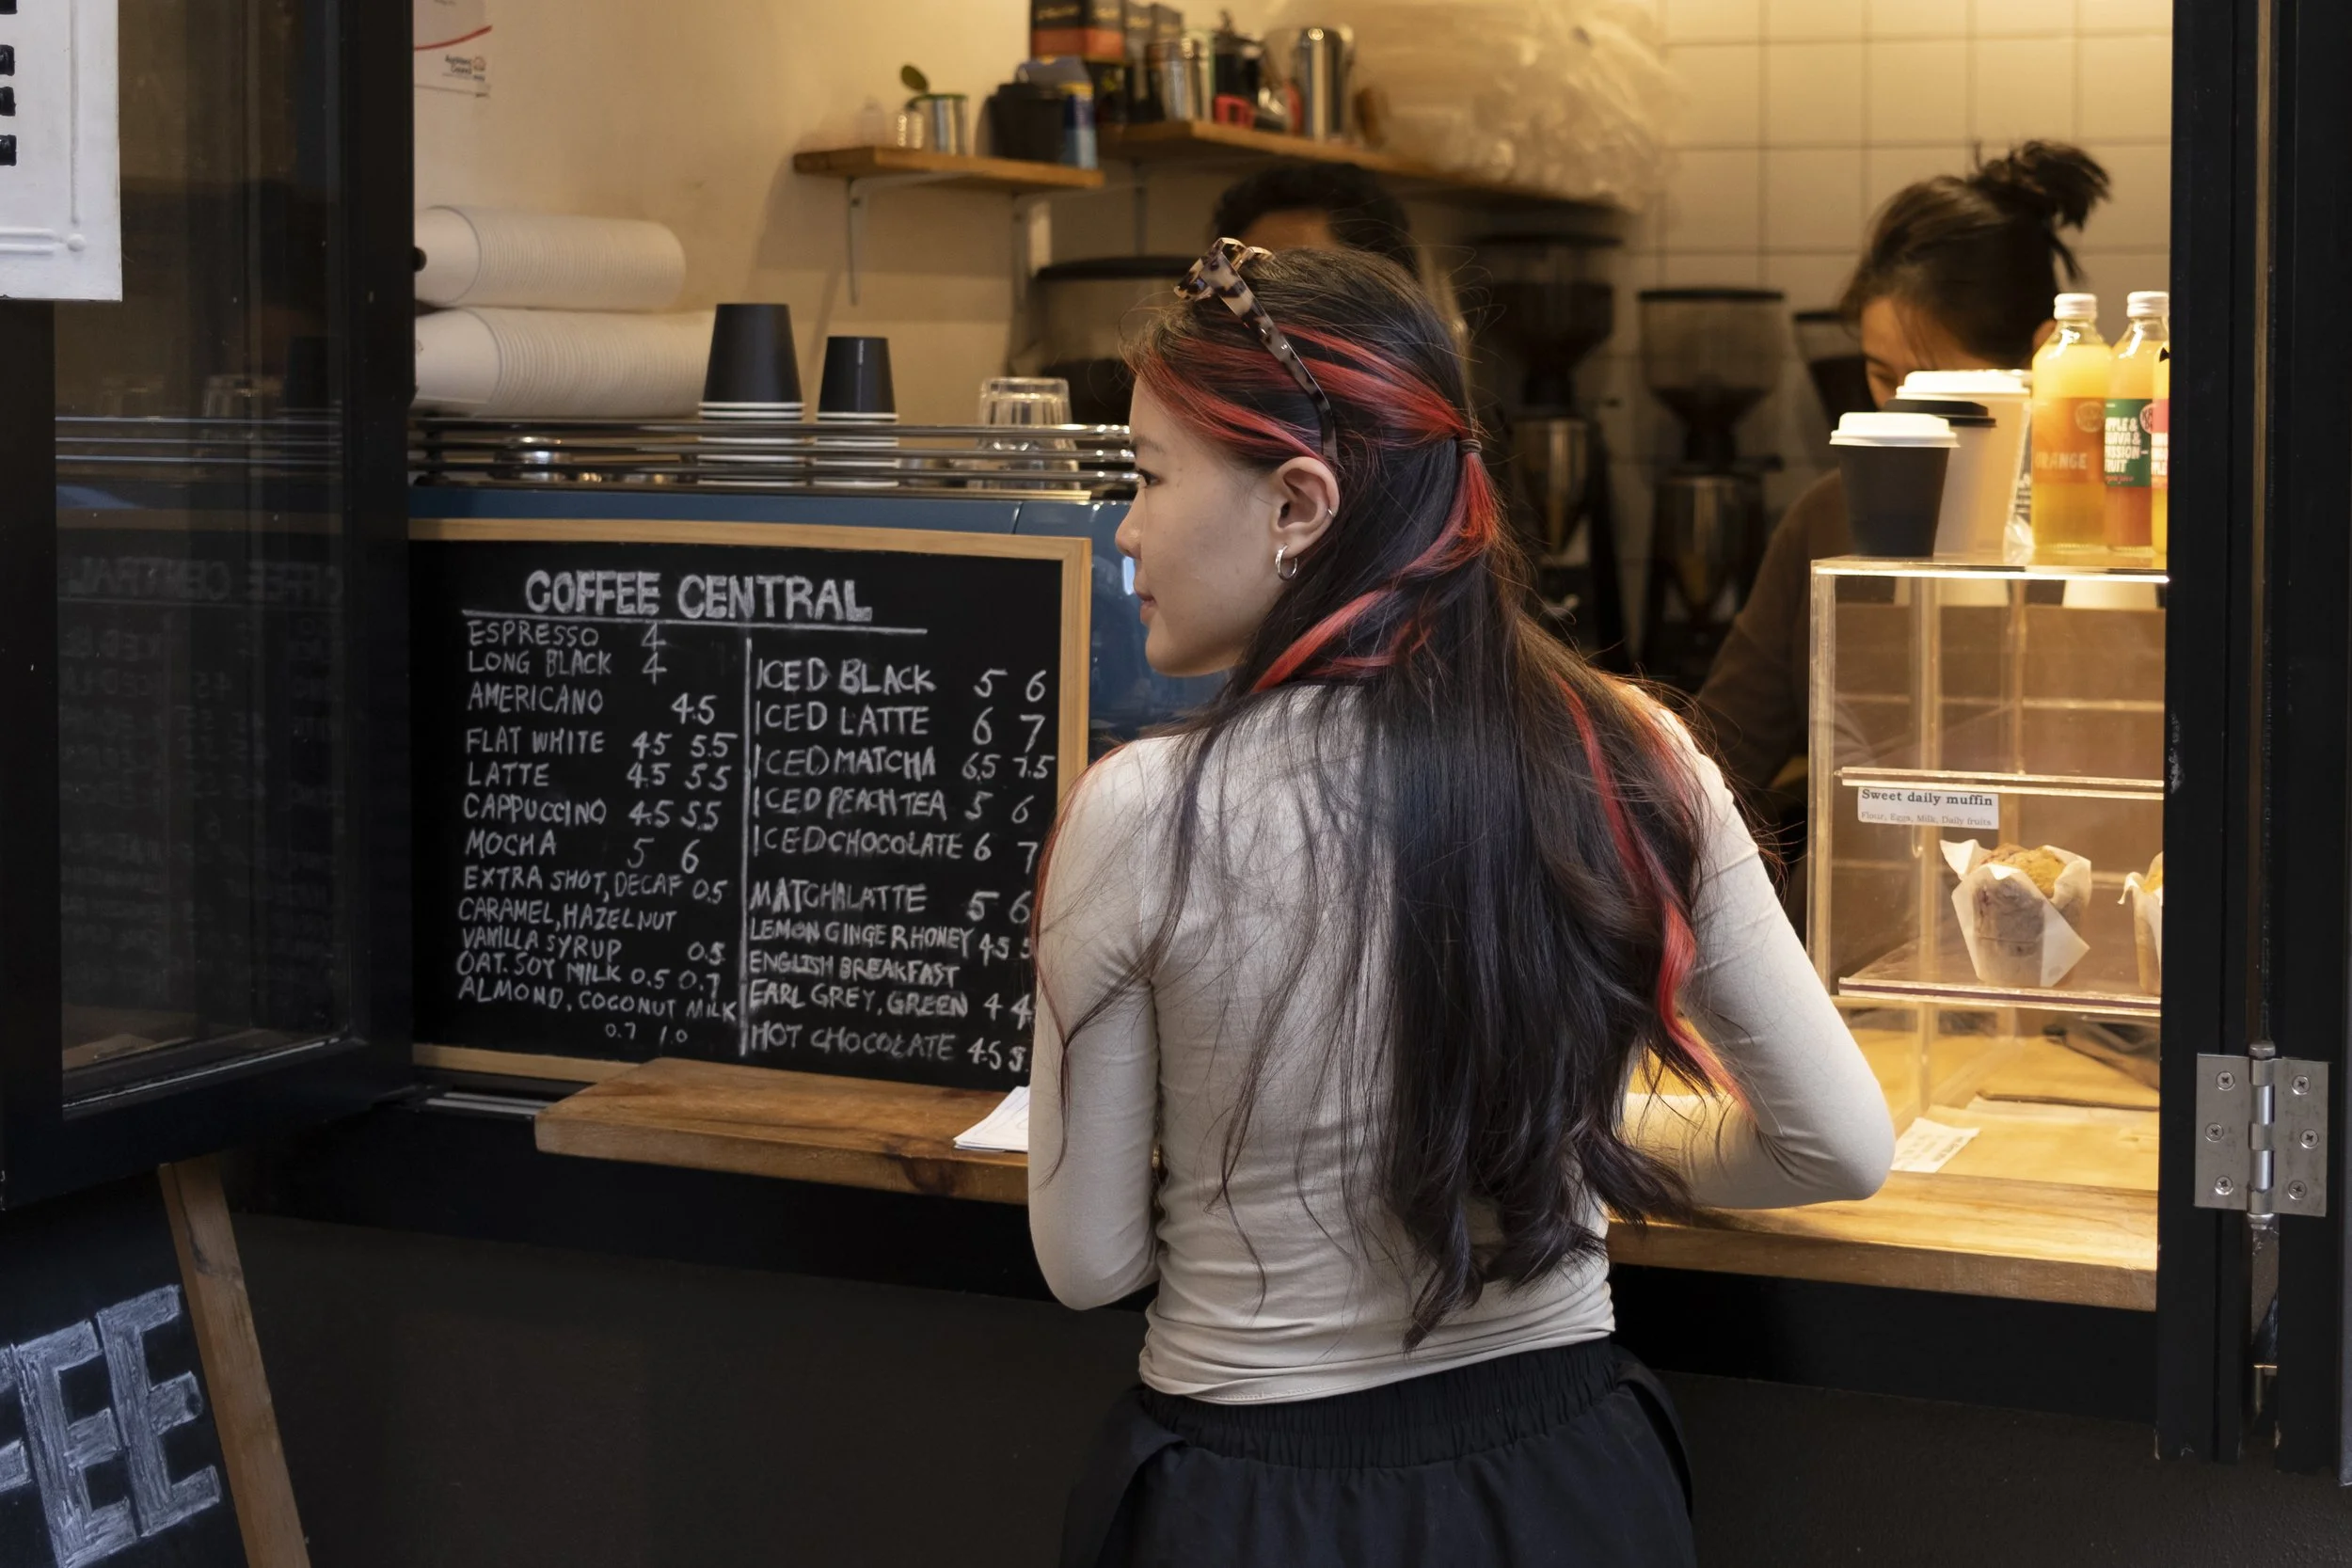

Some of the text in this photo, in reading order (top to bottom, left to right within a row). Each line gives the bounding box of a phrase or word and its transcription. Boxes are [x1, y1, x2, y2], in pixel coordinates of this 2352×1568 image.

[526, 569, 873, 622] COFFEE CENTRAL
[468, 620, 666, 650] ESPRESSO 4
[469, 649, 667, 685] LONG BLACK 4
[756, 657, 1047, 702] ICED BLACK 5 6
[468, 680, 604, 715] AMERICANO
[466, 726, 521, 753] FLAT
[532, 728, 605, 754] WHITE
[755, 701, 1045, 752] ICED LATTE 6 7
[468, 761, 549, 786] LATTE
[754, 743, 830, 780] ICED
[834, 745, 937, 782] MATCHA
[463, 793, 607, 827] CAPPUCCINO
[754, 786, 822, 818] ICED
[964, 791, 993, 820] 5
[1011, 795, 1035, 824] 6
[1862, 789, 1993, 806] Sweet daily muffin
[1942, 816, 1964, 826] Daily
[1966, 816, 1993, 827] fruits
[465, 829, 700, 874] MOCHA 5 6
[828, 829, 963, 860] CHOCOLATE
[973, 832, 992, 862] 6
[1017, 842, 1039, 875] 7
[463, 864, 543, 891] EXTRA
[614, 871, 683, 897] DECAF
[564, 902, 677, 931] HAZELNUT
[966, 890, 1000, 922] 5
[1009, 890, 1032, 924] 6
[462, 925, 539, 951] VANILLA
[547, 934, 622, 962] SYRUP
[749, 917, 820, 943] LEMON
[910, 926, 976, 958] HONEY
[515, 952, 555, 979] SOY
[566, 962, 622, 986] MILK
[630, 968, 671, 990] 0.5
[678, 970, 721, 1000] 0.7
[749, 950, 961, 988] ENGLISH BREAKFAST
[578, 990, 676, 1019] COCONUT
[686, 999, 738, 1022] MILK
[749, 978, 805, 1010] EARL
[886, 990, 969, 1019] GREEN
[983, 992, 1003, 1022] 4
[606, 1022, 636, 1039] 0.7
[751, 1020, 803, 1051] HOT
[810, 1025, 956, 1061] CHOCOLATE
